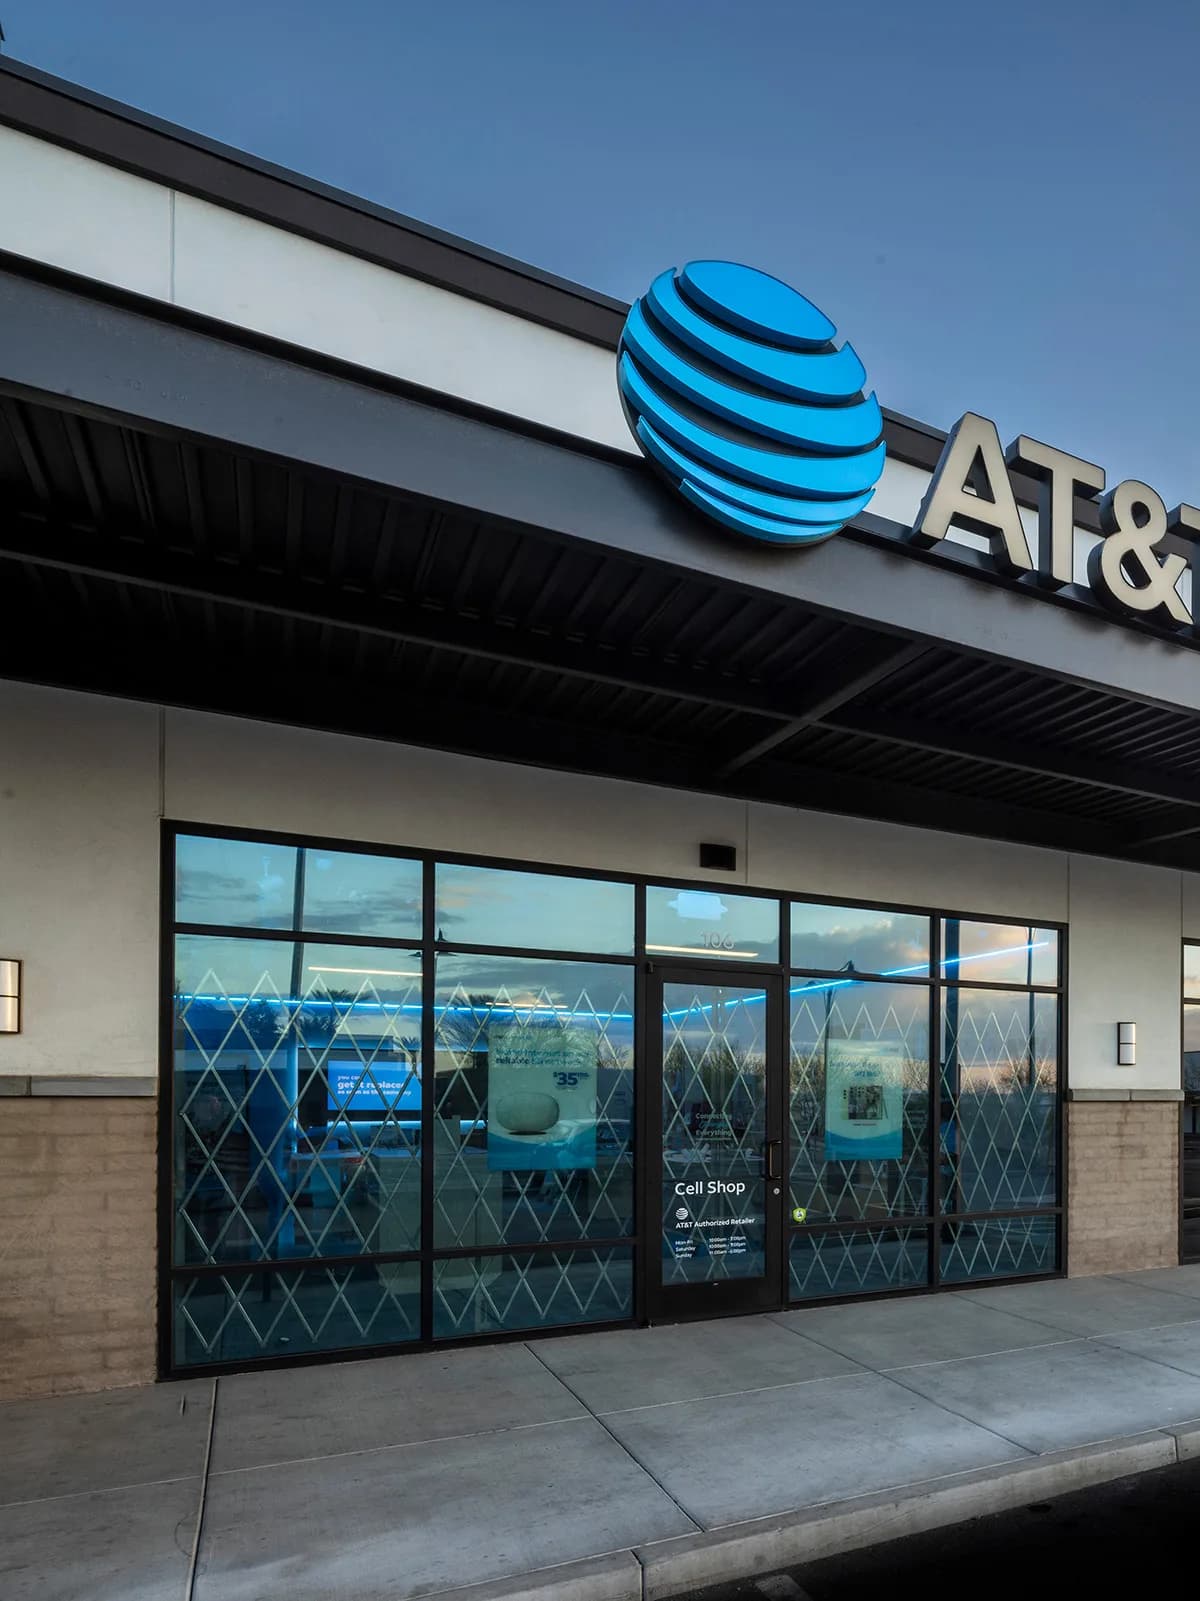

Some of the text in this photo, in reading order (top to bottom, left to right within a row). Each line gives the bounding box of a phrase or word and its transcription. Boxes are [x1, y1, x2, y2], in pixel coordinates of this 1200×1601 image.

[701, 930, 735, 950] 106
[337, 1081, 355, 1090] get
[675, 1180, 746, 1196] Cell Shop
[675, 1217, 756, 1229] AT&T Authorized Retailer
